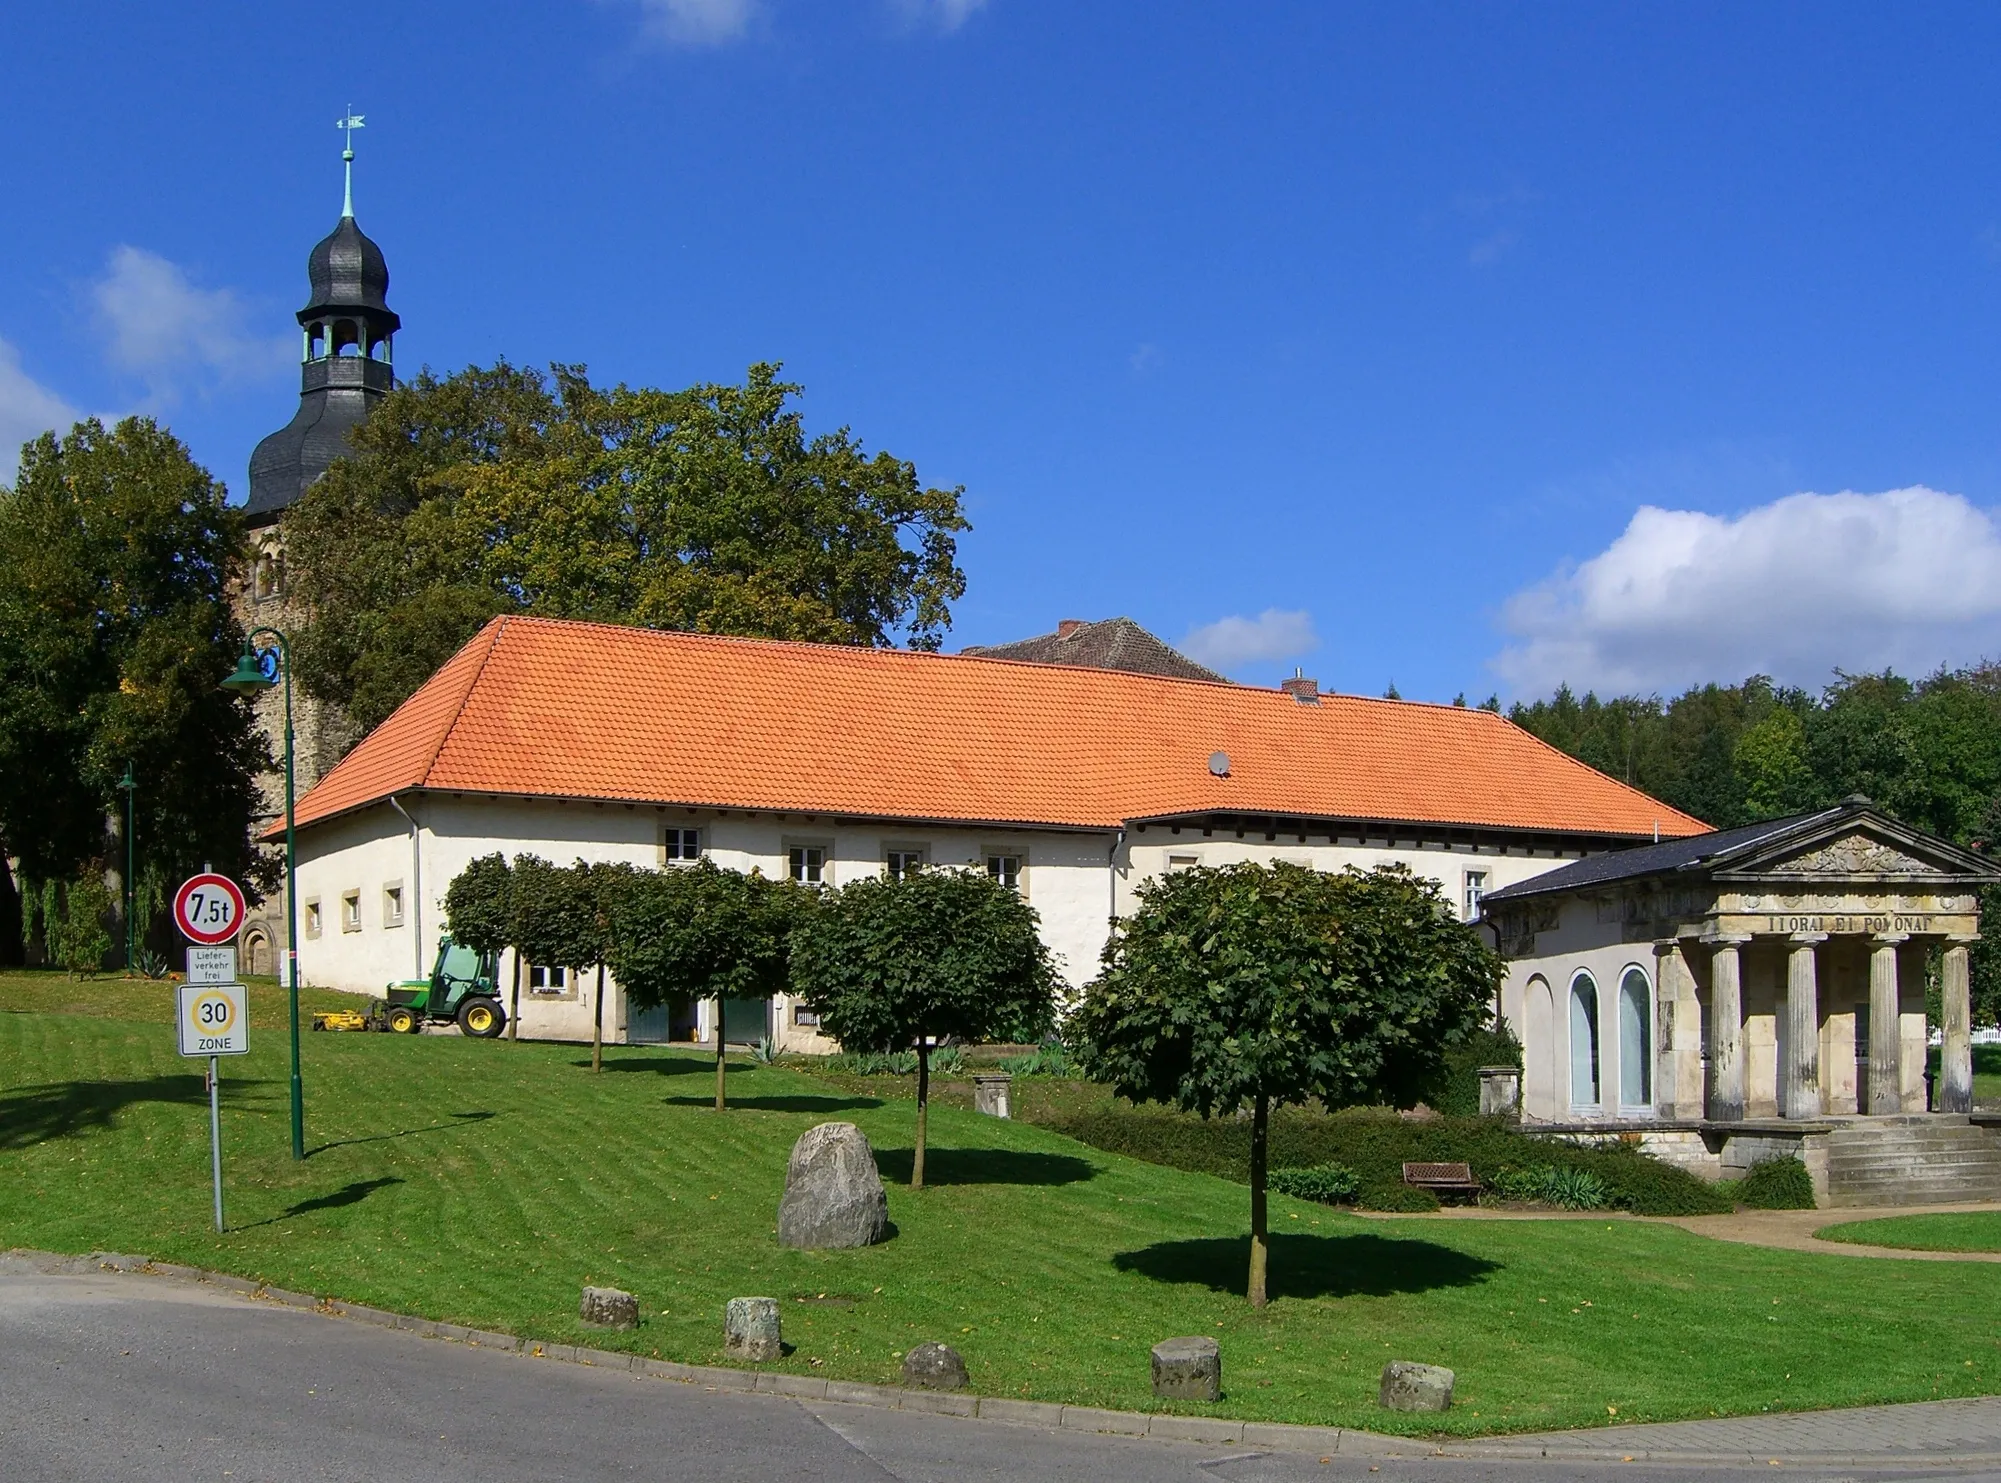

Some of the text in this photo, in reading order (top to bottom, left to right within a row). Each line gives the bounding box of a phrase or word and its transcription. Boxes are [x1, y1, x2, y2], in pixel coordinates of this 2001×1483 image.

[196, 951, 227, 960] Liefer-
[194, 961, 229, 970] verkehr
[204, 971, 220, 980] frei
[201, 1002, 227, 1024] 30
[198, 1037, 232, 1050] ZONE
